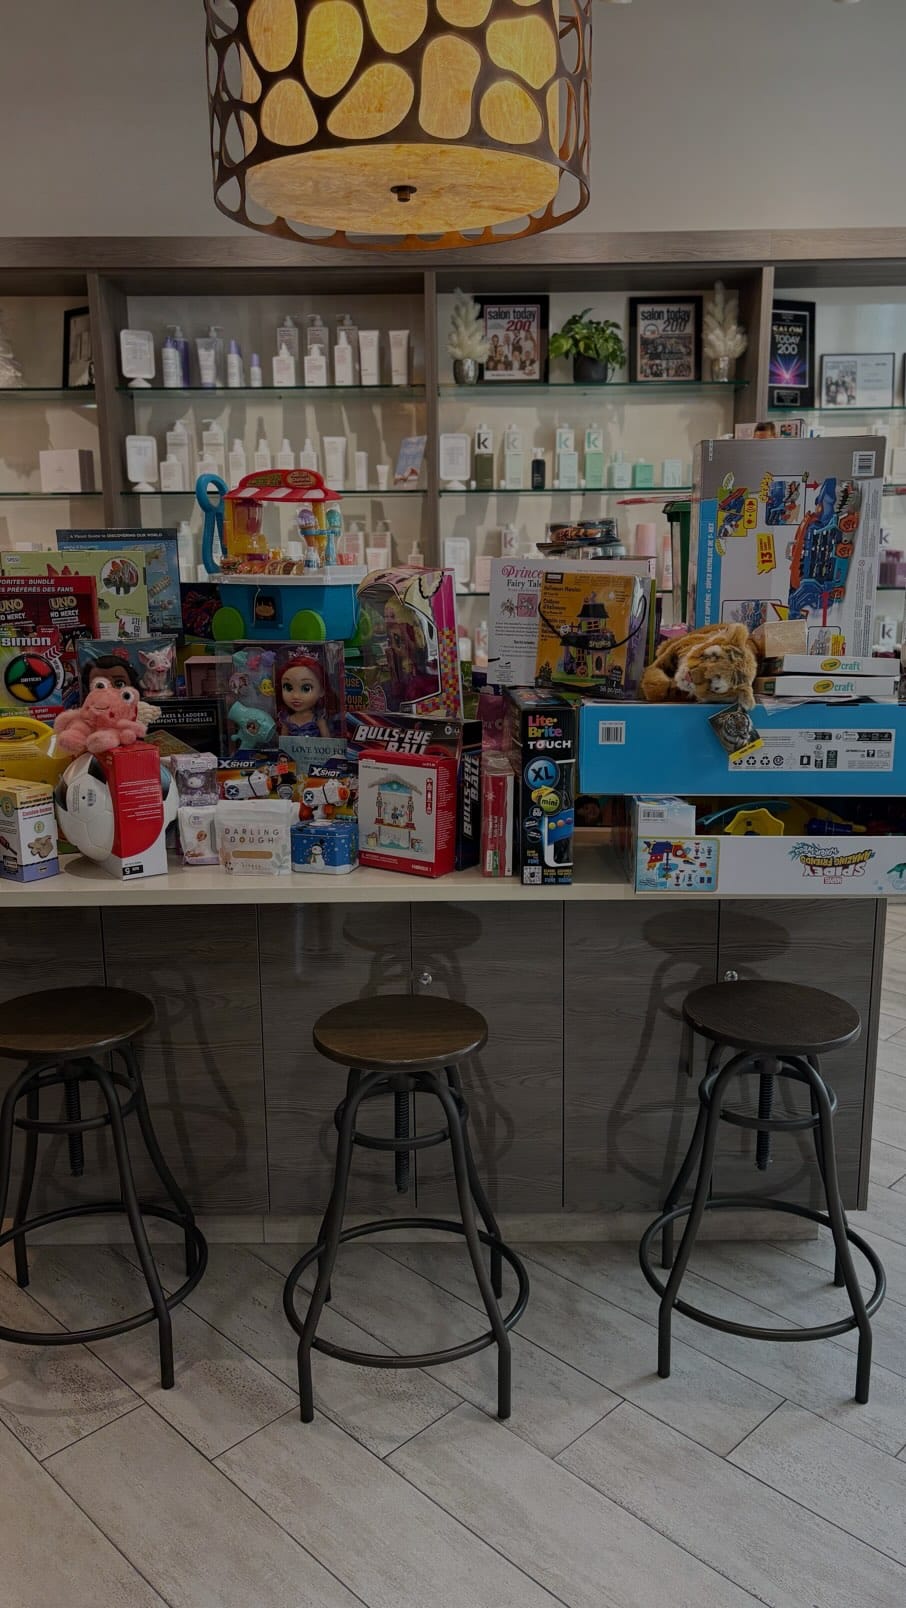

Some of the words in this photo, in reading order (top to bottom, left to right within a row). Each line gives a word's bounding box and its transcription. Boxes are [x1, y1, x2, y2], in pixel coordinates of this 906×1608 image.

[488, 307, 510, 320] salon
[512, 308, 536, 322] today
[641, 307, 664, 320] salon
[666, 308, 690, 322] today
[506, 320, 531, 331] 200
[772, 324, 803, 334] SALON
[776, 335, 800, 343] TODAY
[777, 344, 798, 355] 200
[761, 552, 773, 565] 13
[507, 579, 525, 589] Fairy
[50, 596, 78, 609] UNO
[60, 609, 79, 617] MERCY
[1, 637, 51, 646] simon
[841, 661, 860, 671] craft
[834, 682, 854, 692] craft
[354, 725, 433, 745] BULLS-EYE
[528, 726, 563, 738] Brite
[312, 745, 331, 754] YOU
[386, 741, 427, 754] BALL
[528, 740, 572, 750] TOUCH
[531, 766, 554, 782] XL
[541, 798, 558, 807] mini
[224, 828, 280, 836] DARLING
[230, 836, 274, 844] DOUGH
[800, 855, 833, 866] FRIENDS
[833, 849, 873, 866] AMAZING
[802, 862, 867, 877] SPIDEY
